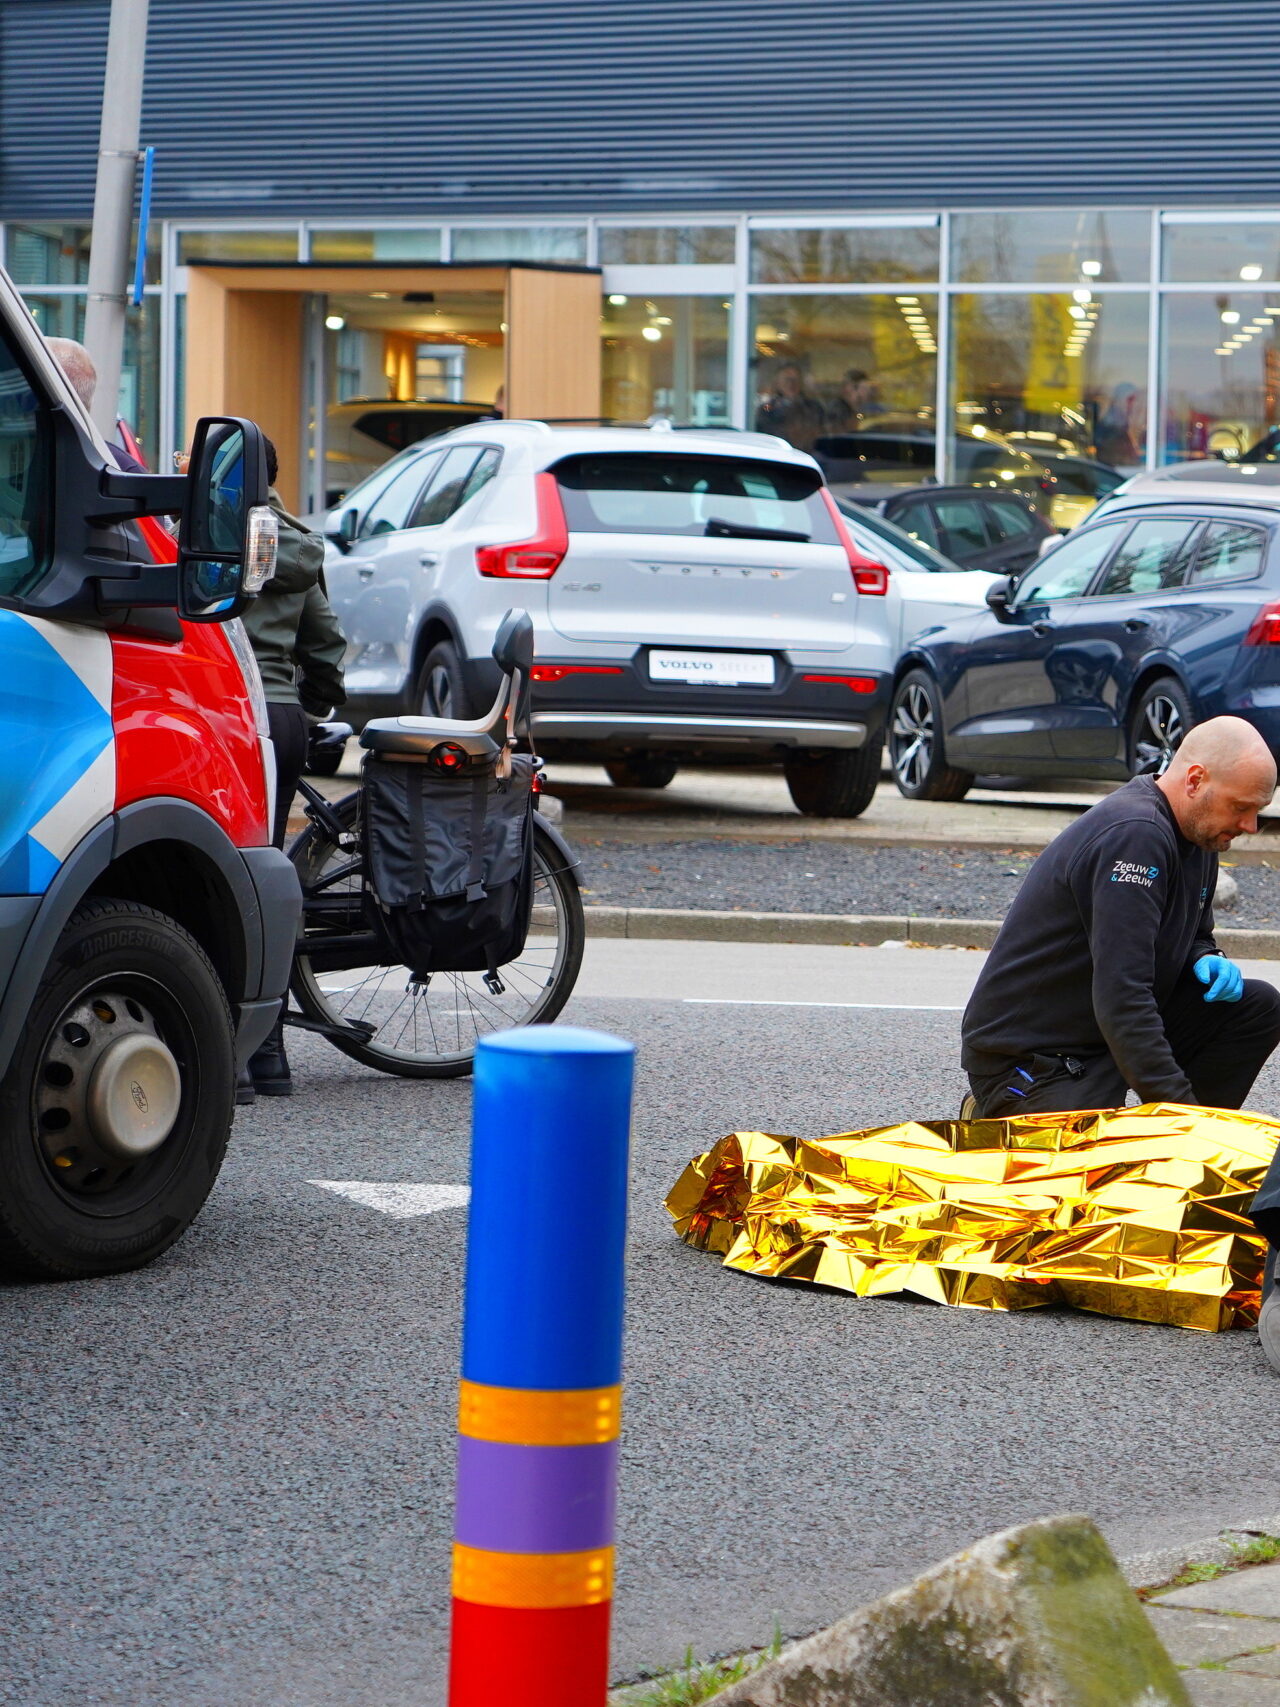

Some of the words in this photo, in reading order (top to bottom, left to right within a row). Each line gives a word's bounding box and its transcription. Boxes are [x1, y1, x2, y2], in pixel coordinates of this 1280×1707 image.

[659, 659, 714, 670] VOLVO
[1112, 860, 1149, 875] Zeeuw
[81, 929, 180, 961] BRIDGESTONE
